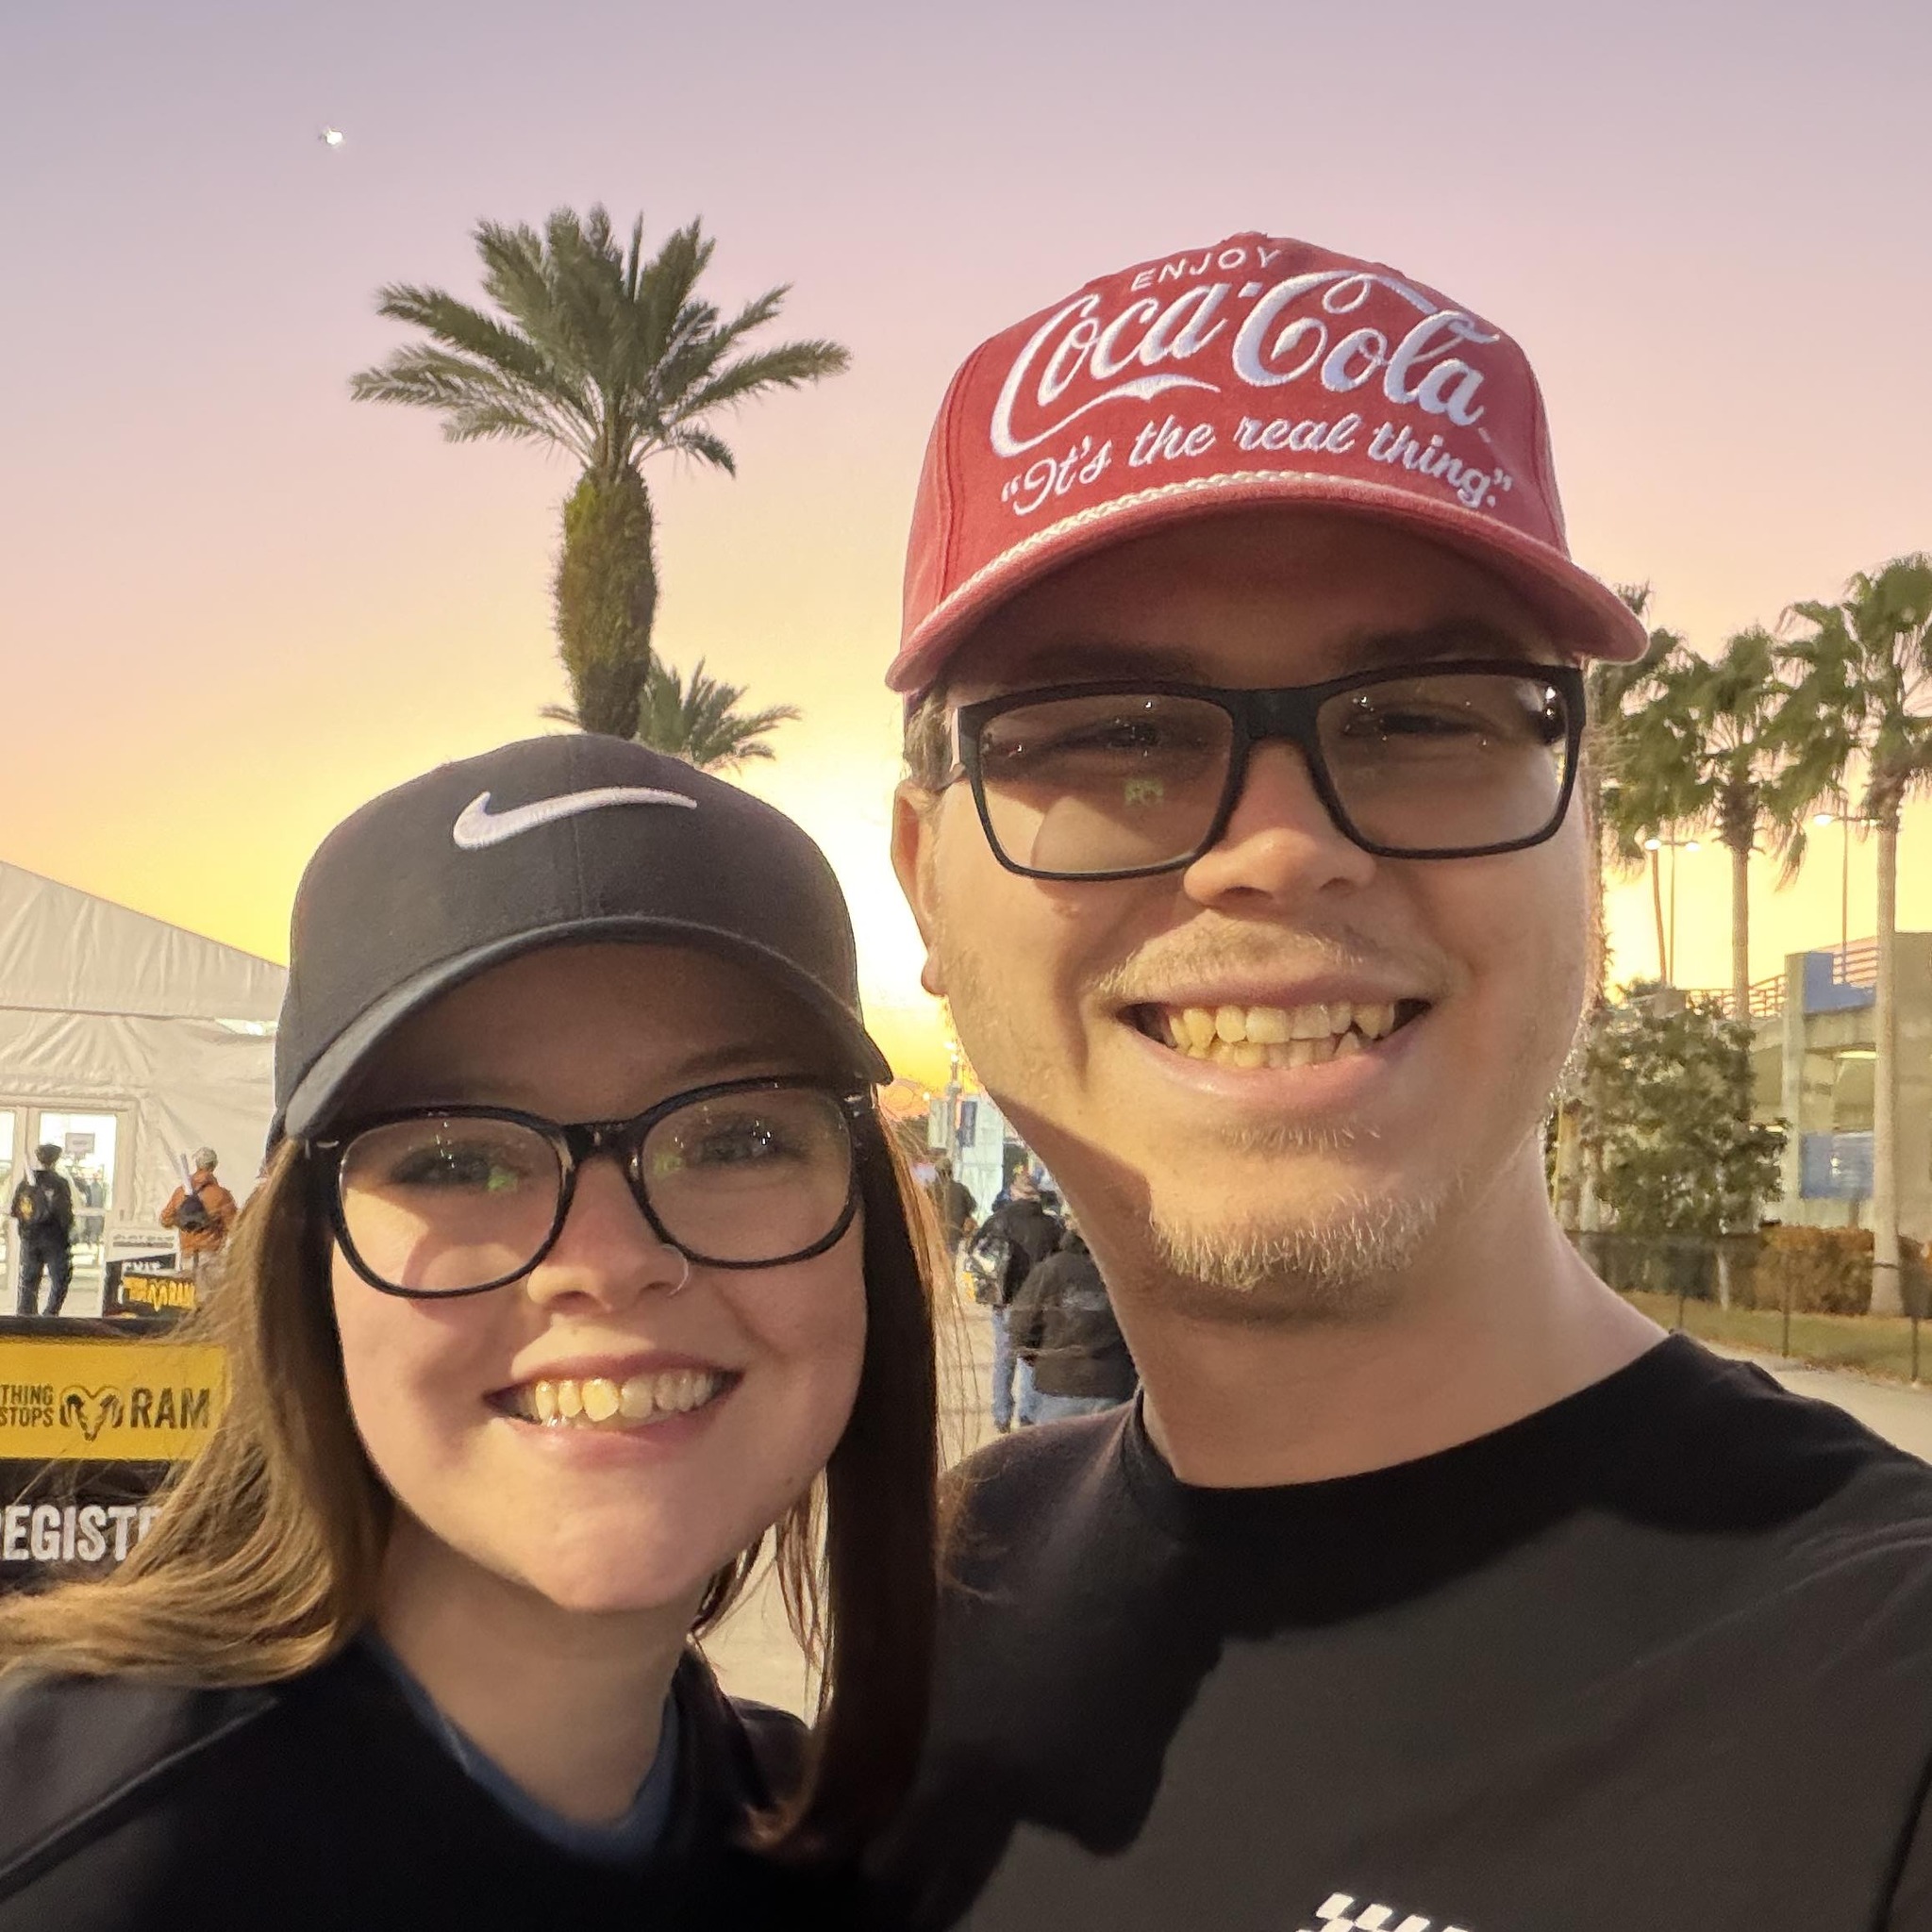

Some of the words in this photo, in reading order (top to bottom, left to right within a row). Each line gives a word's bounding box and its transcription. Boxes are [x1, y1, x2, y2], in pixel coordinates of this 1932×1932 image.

[1131, 245, 1281, 292] ENJOY
[990, 269, 1500, 458] Coca-Cola
[1127, 414, 1217, 468] the
[1233, 412, 1362, 455] real
[0, 1384, 54, 1407] THING
[0, 1407, 55, 1427] STOPS
[129, 1387, 210, 1429] RAM
[0, 1505, 161, 1562] EGIST
